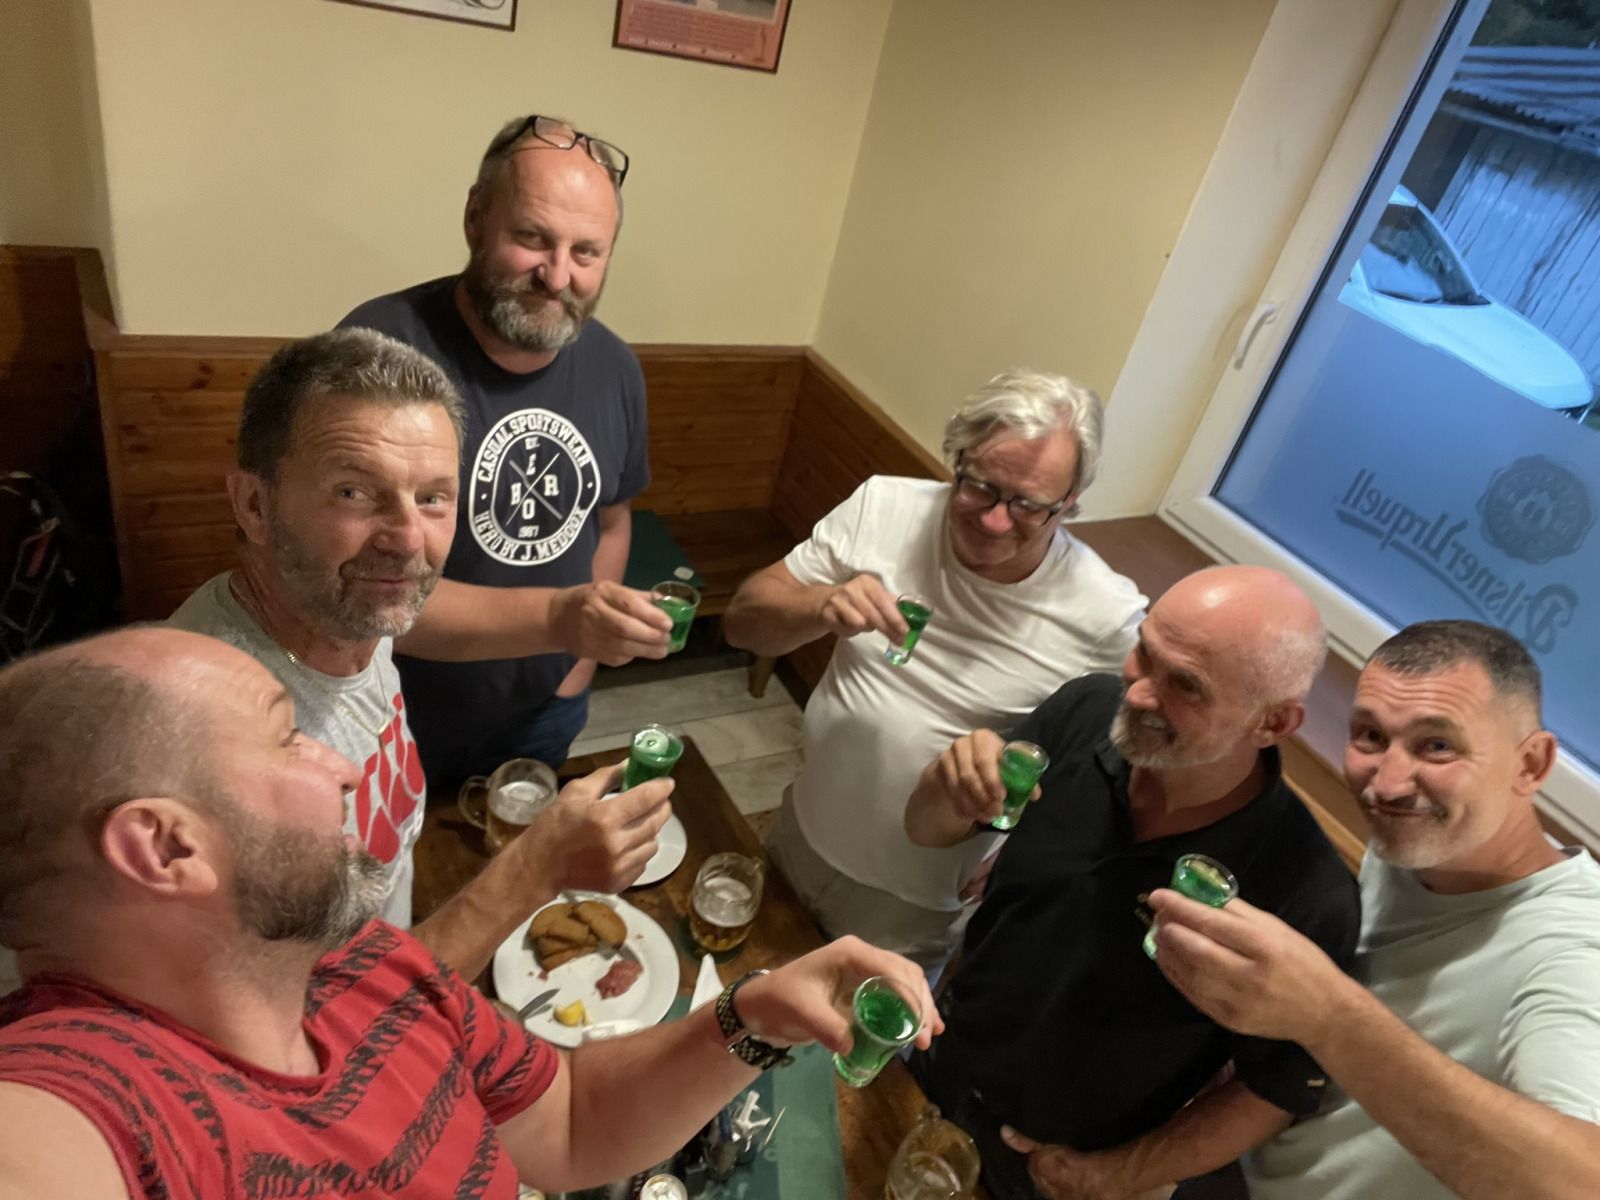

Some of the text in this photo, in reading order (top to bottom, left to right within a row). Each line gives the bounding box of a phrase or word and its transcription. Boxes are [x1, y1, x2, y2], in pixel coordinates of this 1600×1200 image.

[477, 413, 591, 482] CASUAL SPORTSWEAR
[474, 510, 503, 550] HERO
[499, 540, 519, 560] BY
